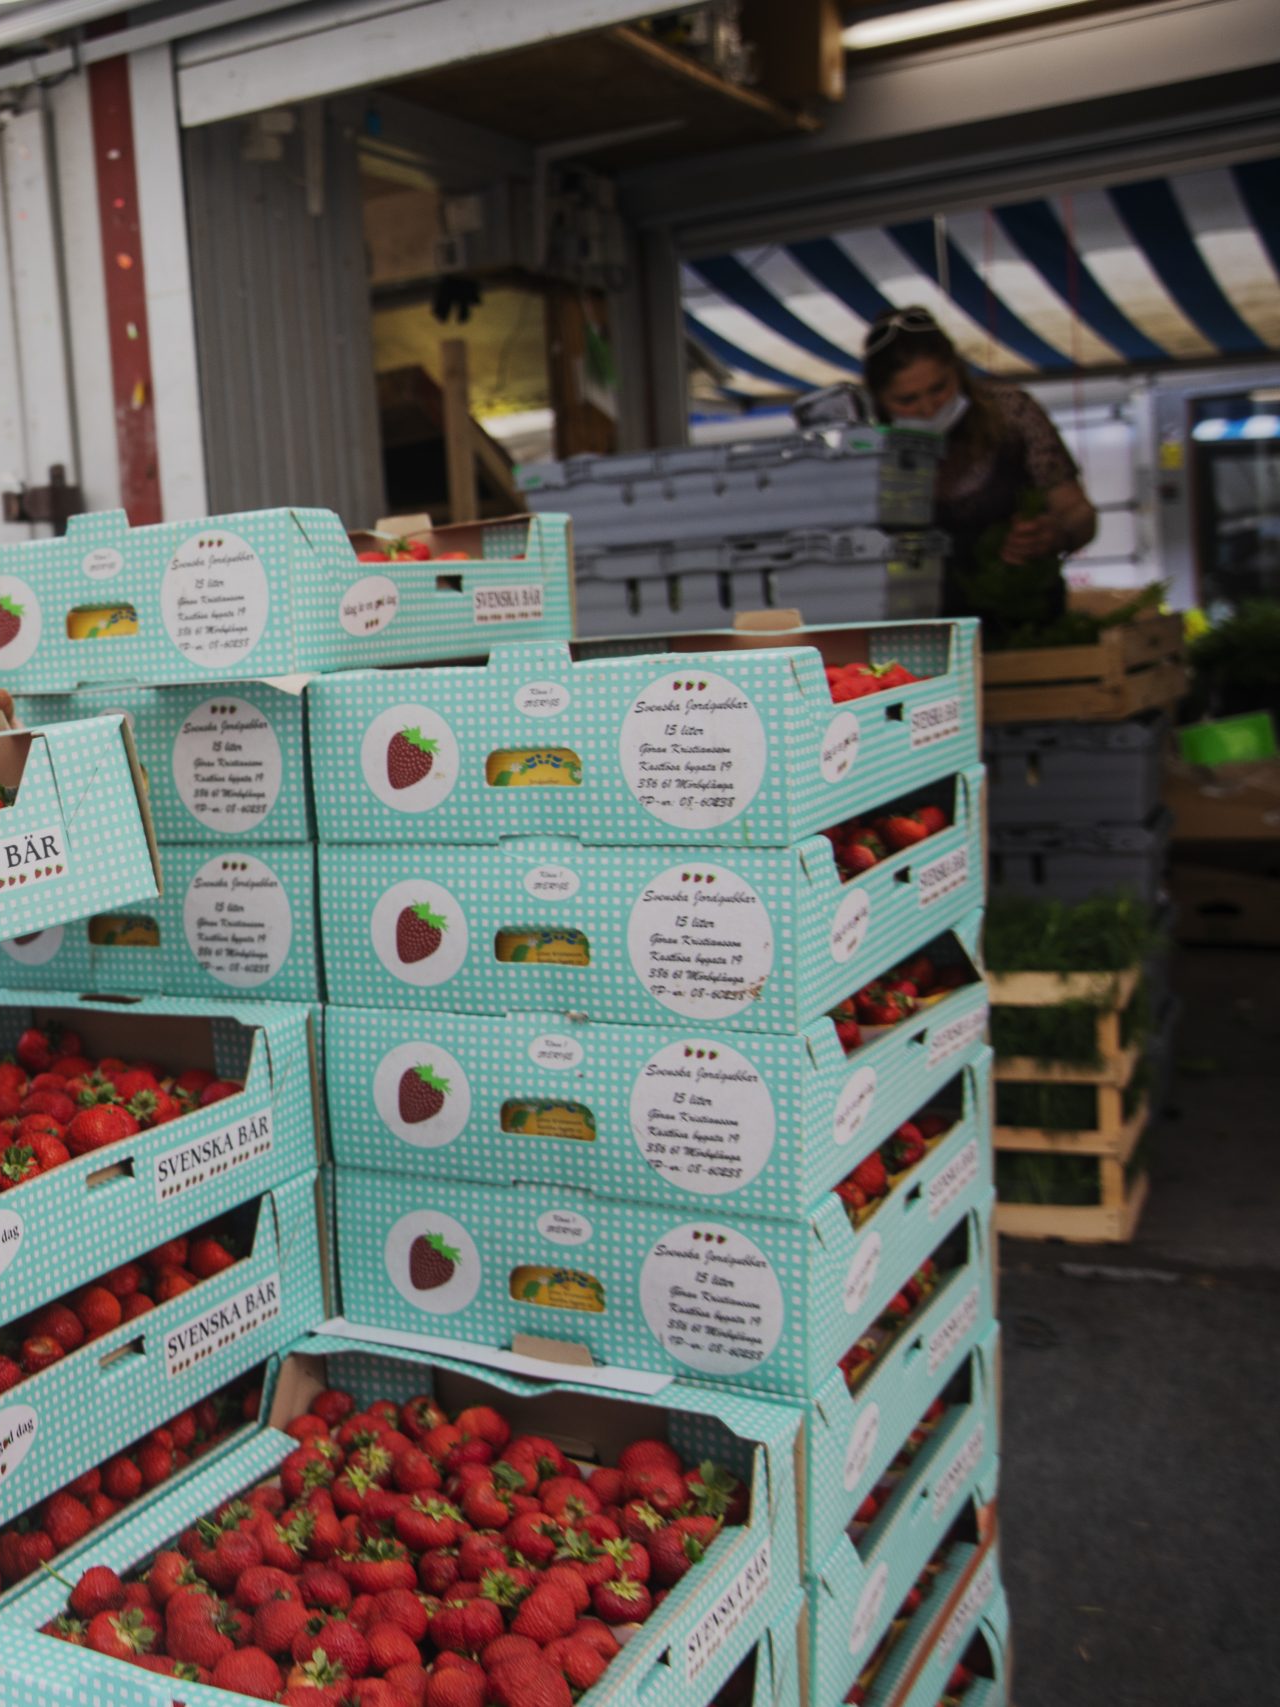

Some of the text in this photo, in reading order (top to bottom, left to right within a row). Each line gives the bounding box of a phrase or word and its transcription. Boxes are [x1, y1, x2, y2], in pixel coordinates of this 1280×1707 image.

[634, 698, 748, 715] Svenska Jordgubbar
[664, 724, 704, 735] 15 liter
[639, 743, 731, 757] Göran Kristiansson
[720, 761, 733, 771] 19
[661, 779, 672, 788] 61
[4, 834, 60, 869] BÄR
[643, 890, 756, 906] Svenska Jordgubbar
[675, 915, 714, 928] 15 liter
[645, 1064, 758, 1083] Svenska Jordgubbar
[673, 1092, 712, 1106] 15 liter
[158, 1116, 269, 1182] SVENSKA BÄR
[2, 1226, 19, 1243] dag
[654, 1244, 700, 1260] Svenska
[695, 1271, 708, 1283] 15
[168, 1282, 276, 1359] SVENSKA BÄR
[16, 1419, 33, 1437] dag
